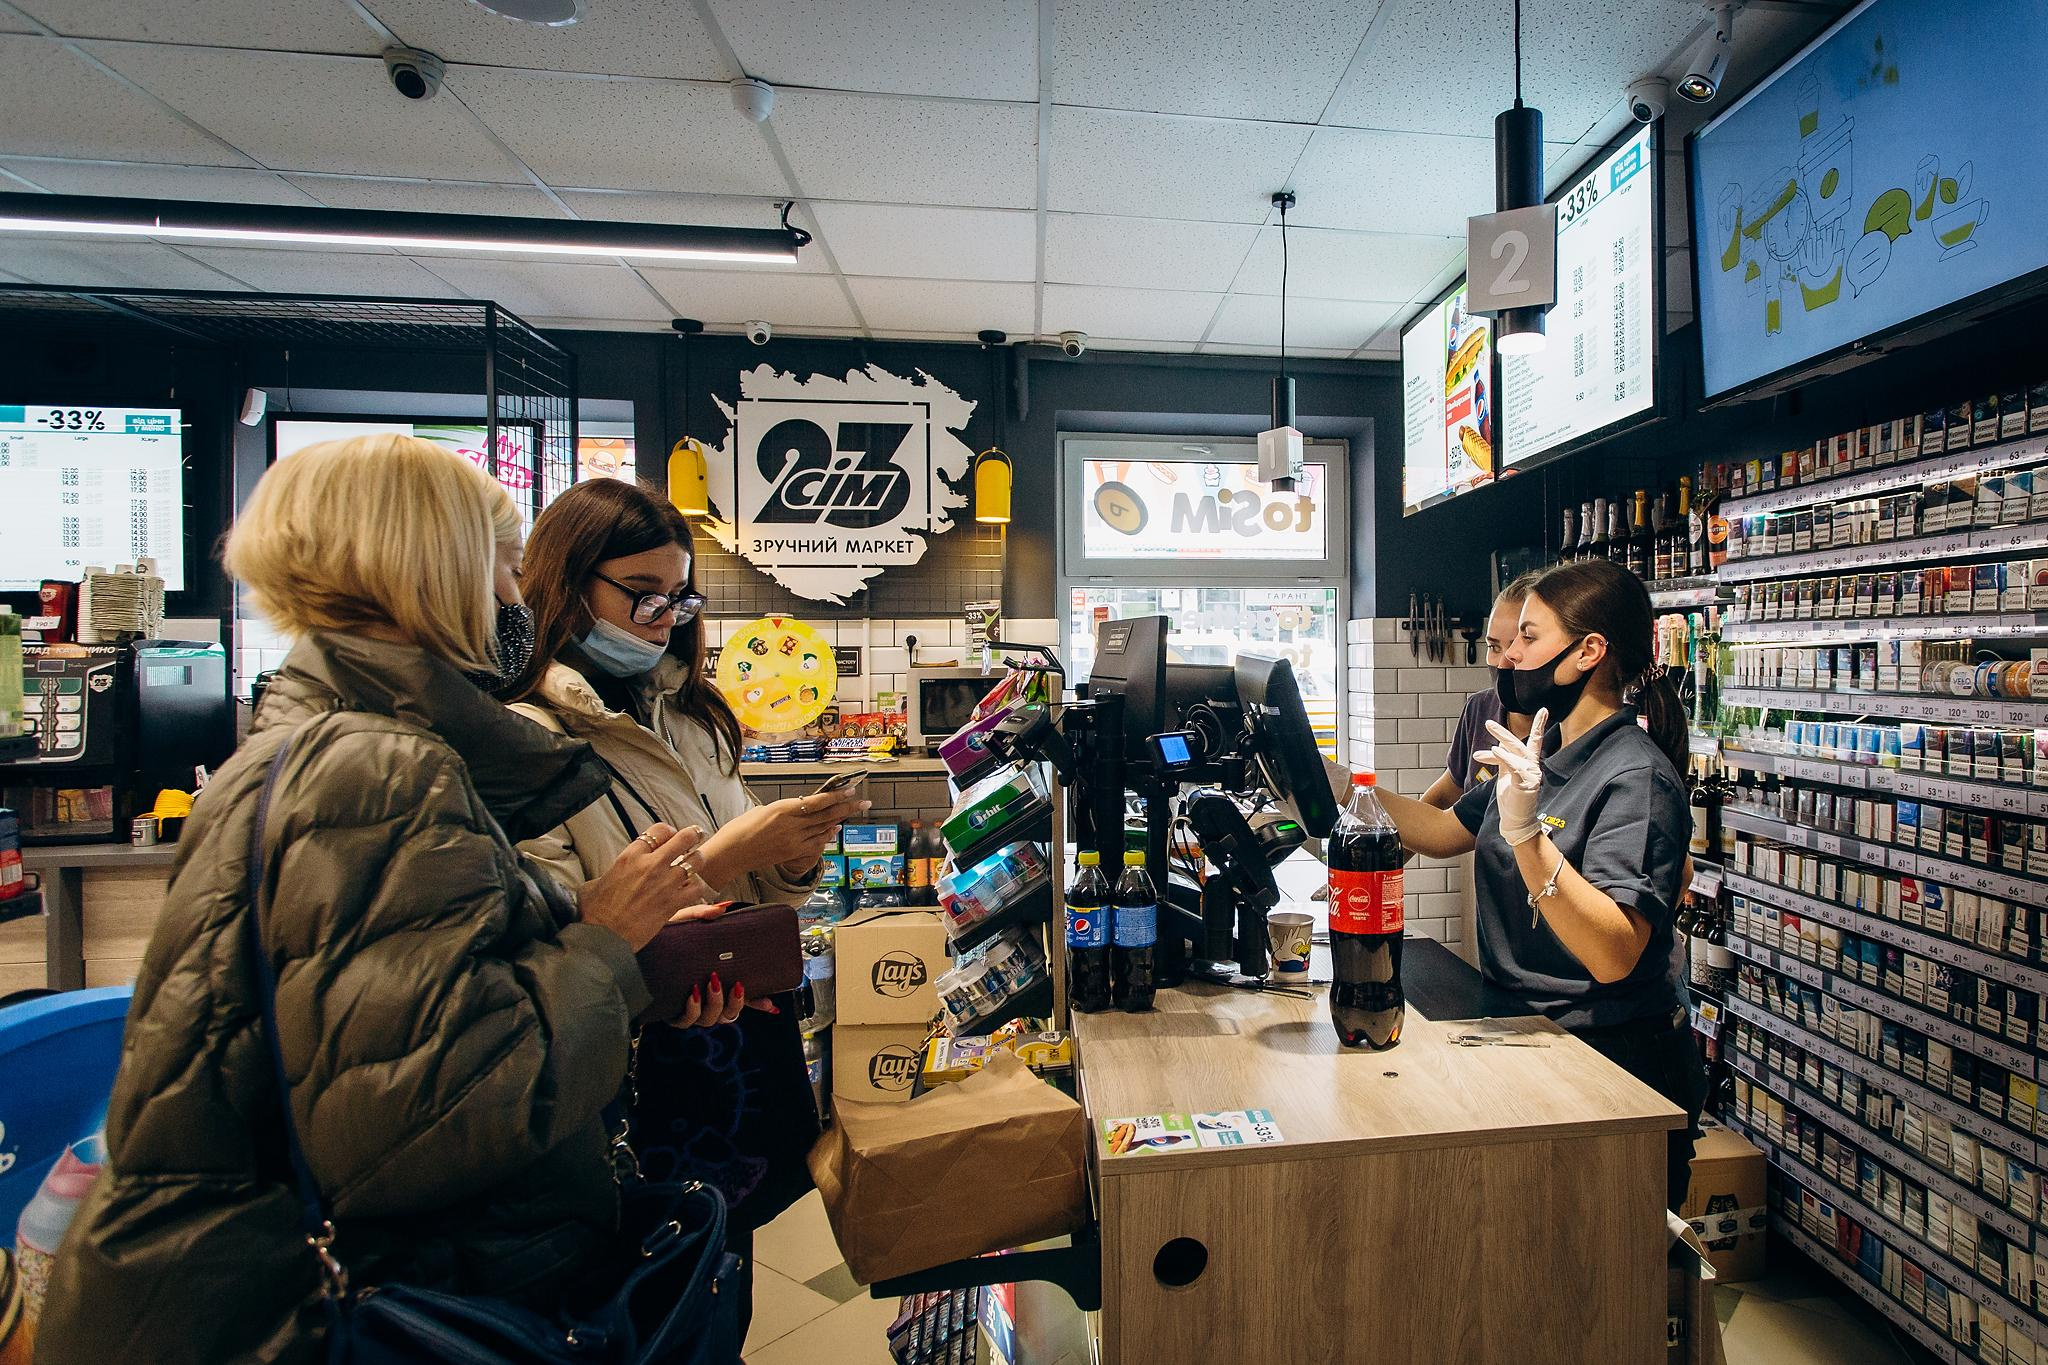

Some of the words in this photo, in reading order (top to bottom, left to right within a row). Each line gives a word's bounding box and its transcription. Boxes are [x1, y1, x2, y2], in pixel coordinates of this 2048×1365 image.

[1560, 174, 1598, 222] -33%
[1489, 230, 1531, 296] 2
[37, 410, 105, 430] -33%
[482, 435, 522, 461] My
[464, 452, 532, 486] Slsh
[753, 536, 837, 553] ЗРУЧНИЙ
[846, 539, 914, 554] МАРКЕТ
[1267, 592, 1308, 600] ГАРАНТ
[966, 612, 982, 620] -33%
[22, 646, 50, 655] ОЛАД
[830, 738, 865, 748] SNICKERS
[971, 804, 1001, 827] Orbit
[868, 865, 886, 875] Барні
[876, 961, 922, 992] Lay's
[874, 1055, 920, 1085] Lay's
[1254, 1123, 1276, 1143] -33%
